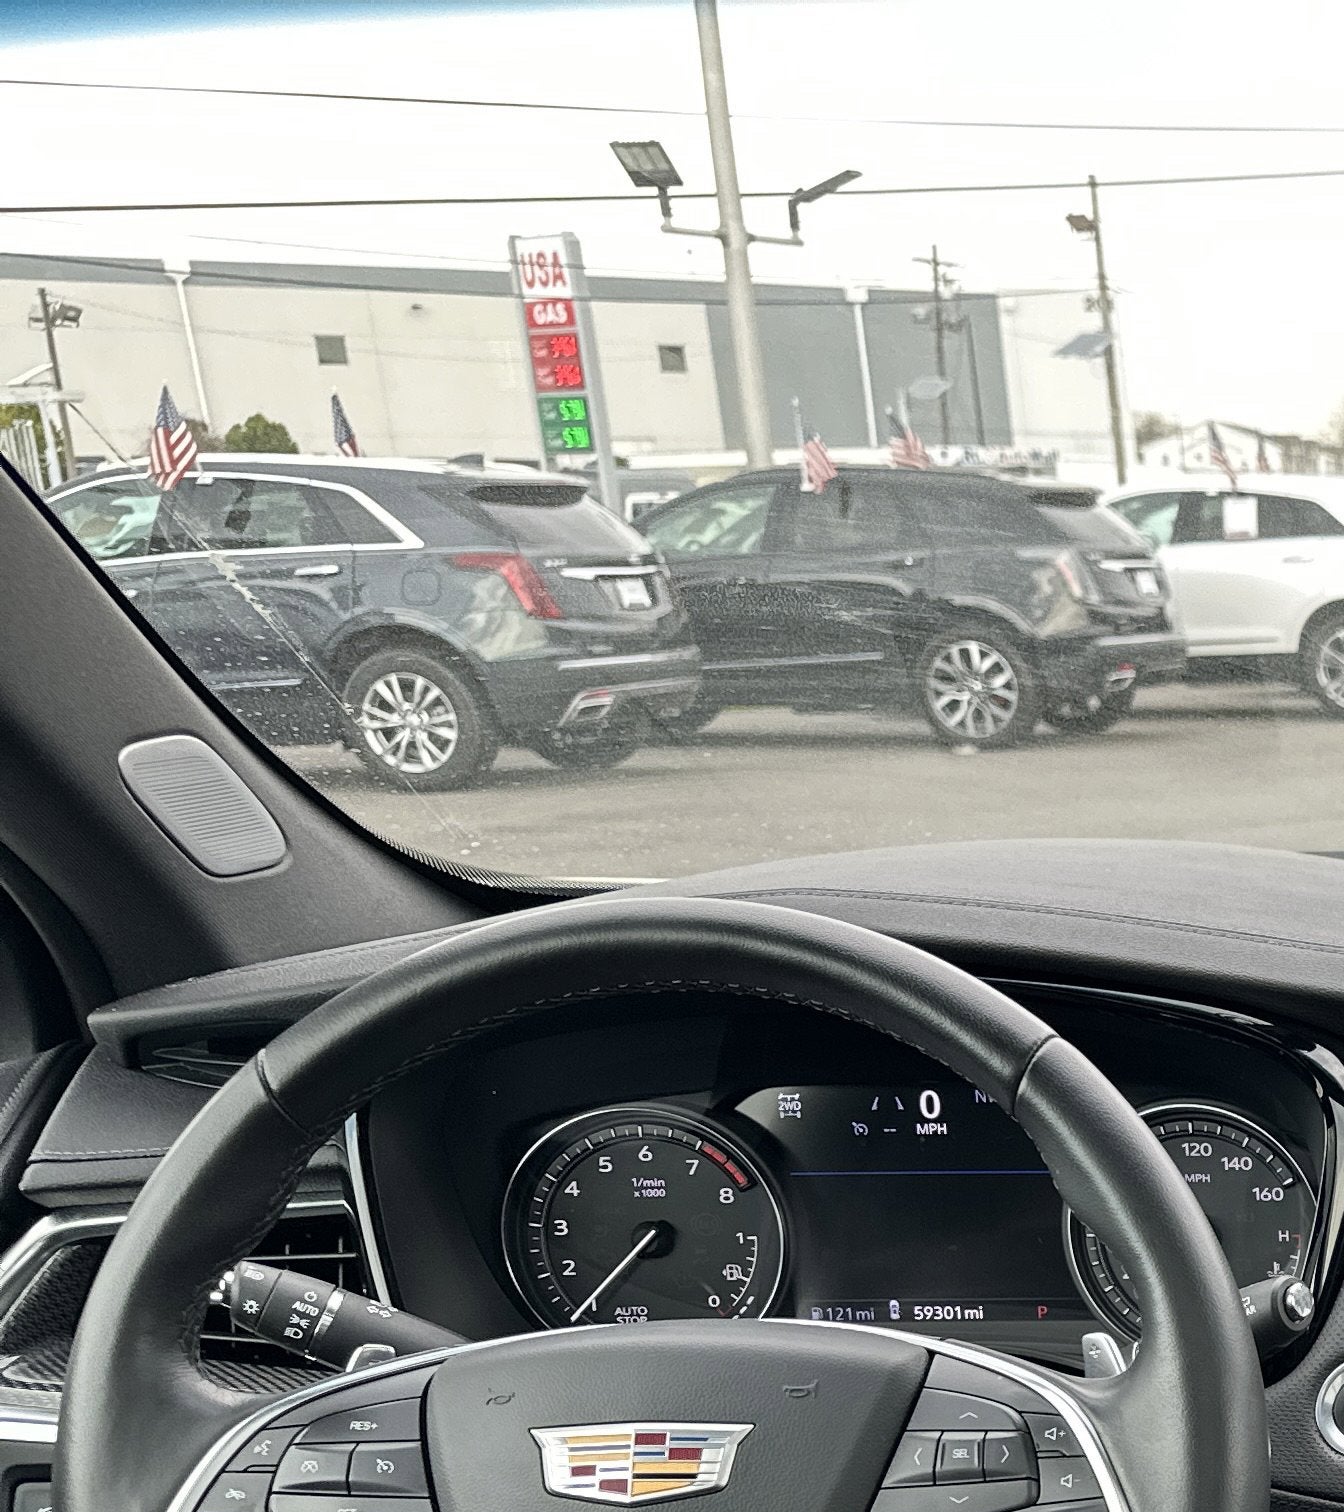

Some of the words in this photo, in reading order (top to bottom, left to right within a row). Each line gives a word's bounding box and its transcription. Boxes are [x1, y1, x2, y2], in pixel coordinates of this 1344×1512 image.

[520, 250, 567, 289] USA
[532, 303, 567, 325] GAS
[778, 1101, 801, 1111] 2WD
[919, 1090, 940, 1119] 0
[916, 1123, 947, 1135] MPH
[638, 1145, 653, 1162] 6
[1182, 1143, 1212, 1157] 120
[598, 1157, 613, 1172] 5
[685, 1160, 699, 1175] 7
[1221, 1157, 1252, 1171] 140
[631, 1177, 666, 1188] 1/min
[1185, 1174, 1210, 1183] MPH
[565, 1181, 580, 1196] 4
[633, 1188, 666, 1198] x1000
[1252, 1187, 1284, 1202] 160
[719, 1188, 734, 1204] 8
[554, 1220, 569, 1235] 3
[735, 1232, 744, 1244] 1
[1278, 1230, 1289, 1242] H
[562, 1260, 577, 1276] 2
[708, 1295, 720, 1307] 0
[291, 1301, 319, 1317] AUTO
[614, 1306, 648, 1317] AUTO
[1037, 1306, 1048, 1318] P
[952, 1448, 970, 1459] SEL
